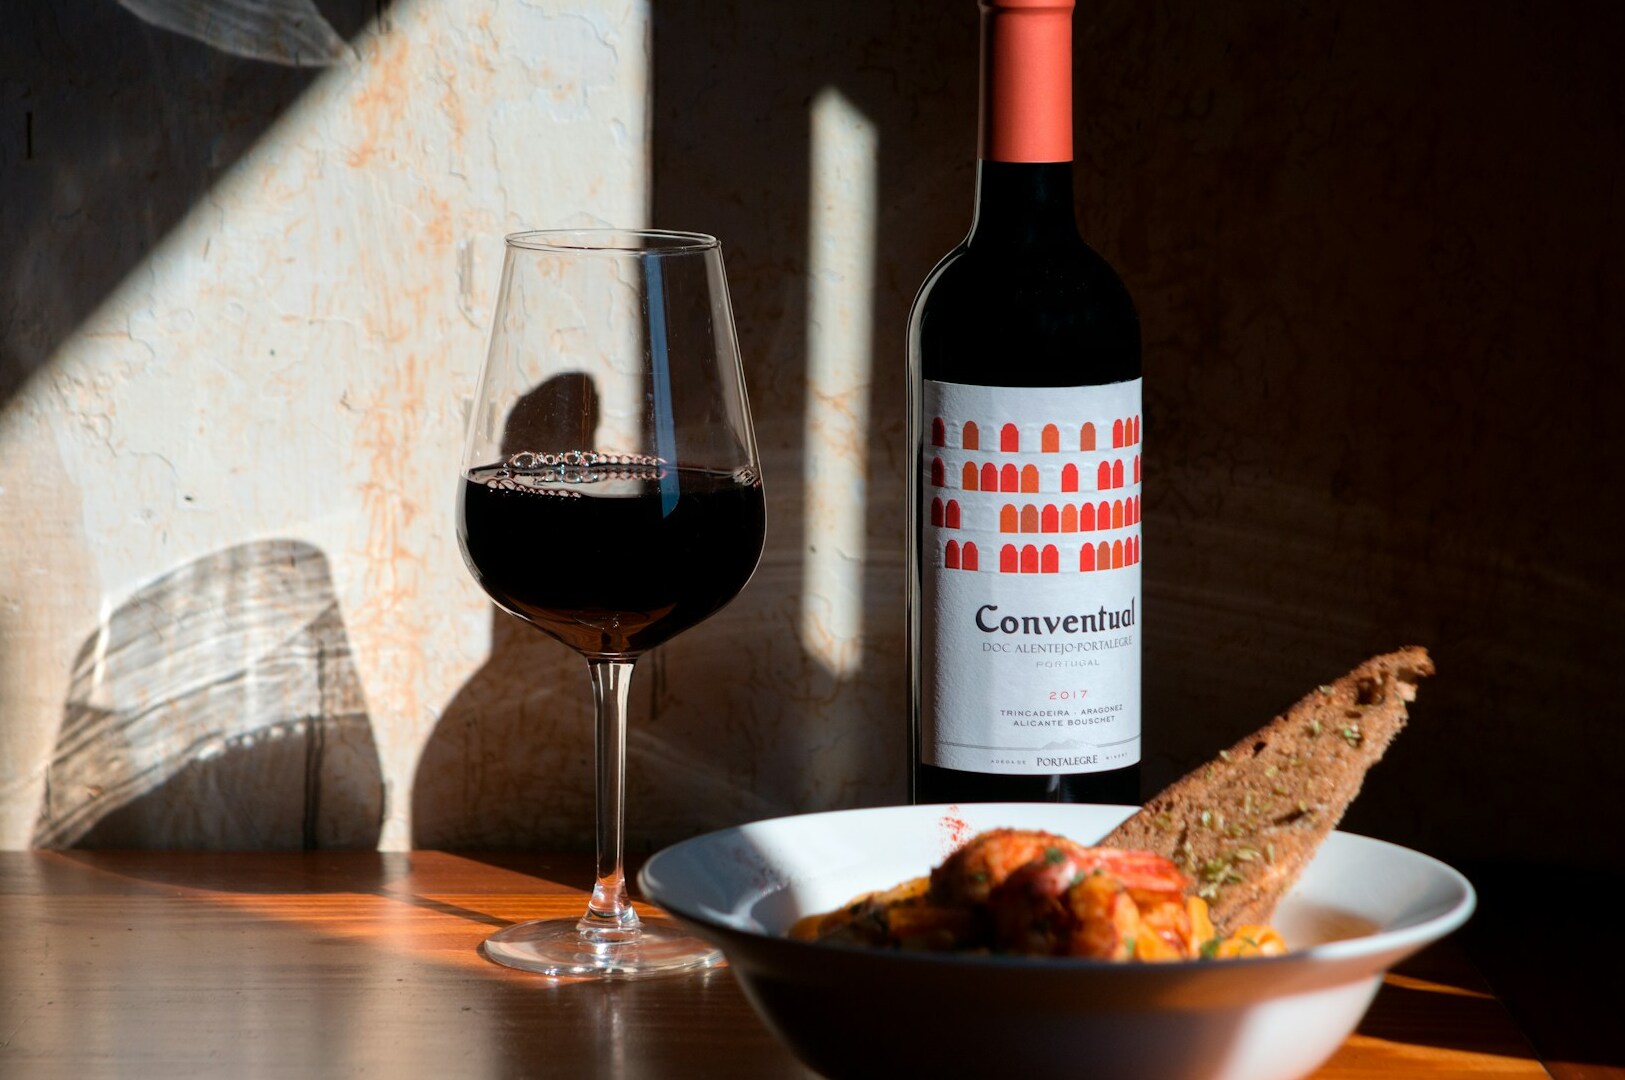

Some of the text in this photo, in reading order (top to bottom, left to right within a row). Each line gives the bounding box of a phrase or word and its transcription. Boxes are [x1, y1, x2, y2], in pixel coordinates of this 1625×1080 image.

[975, 596, 1135, 635] Conventual
[982, 642, 1012, 653] DOC
[1036, 659, 1100, 668] PORTUGAL
[1049, 690, 1088, 700] 2017
[1000, 704, 1123, 717] TRINCADEIRA ARAGONEZ
[1067, 715, 1116, 726] BOUSCHET
[1036, 755, 1098, 767] PORTALEGRE
